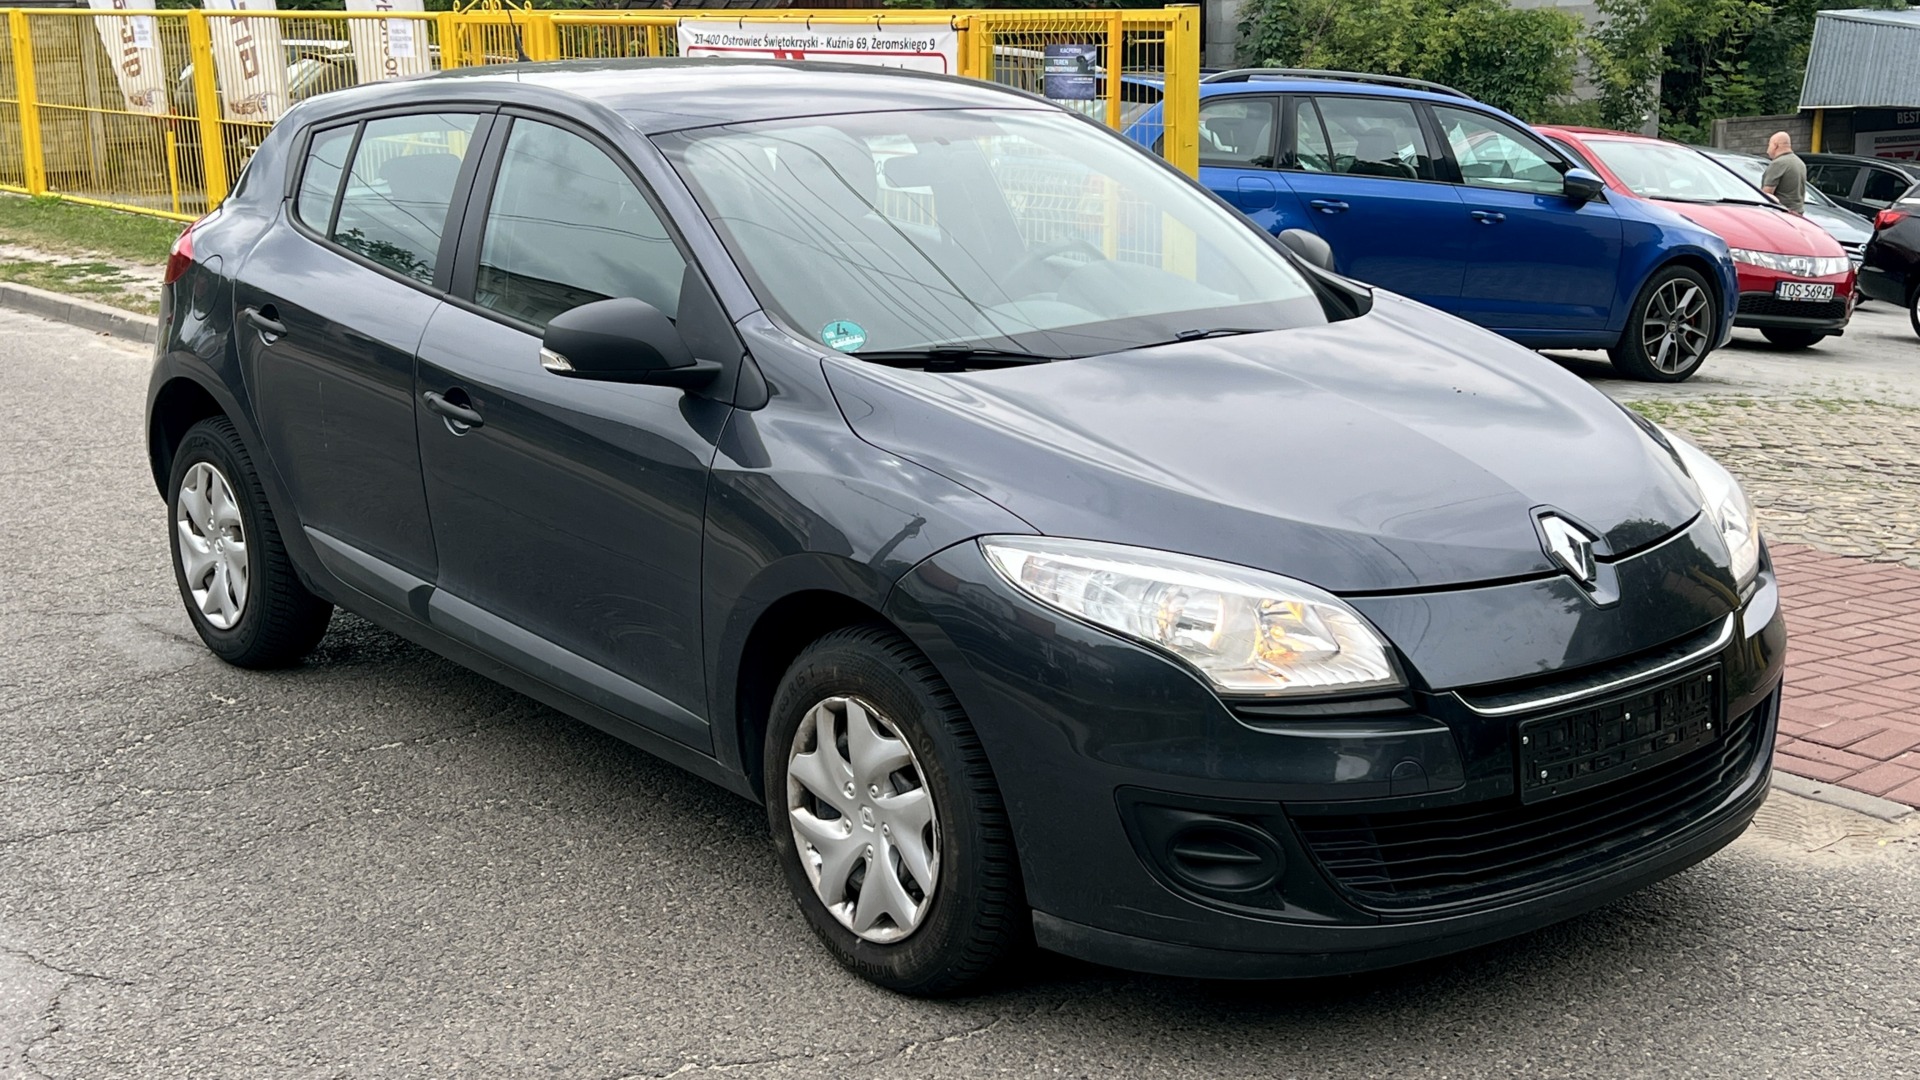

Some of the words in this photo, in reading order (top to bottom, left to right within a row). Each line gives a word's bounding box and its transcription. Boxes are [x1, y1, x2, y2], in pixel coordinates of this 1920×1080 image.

[694, 33, 721, 45] 27-400
[721, 34, 762, 47] Ostrowiec
[763, 33, 818, 51] Świętokrzyski
[826, 36, 854, 49] Kuźnia
[856, 37, 869, 51] 69,
[871, 34, 928, 54] Żeromskiego
[929, 38, 936, 51] 9
[1897, 111, 1920, 125] BEST
[1783, 283, 1802, 297] TOS
[1804, 285, 1833, 299] 56943
[836, 322, 849, 336] 4
